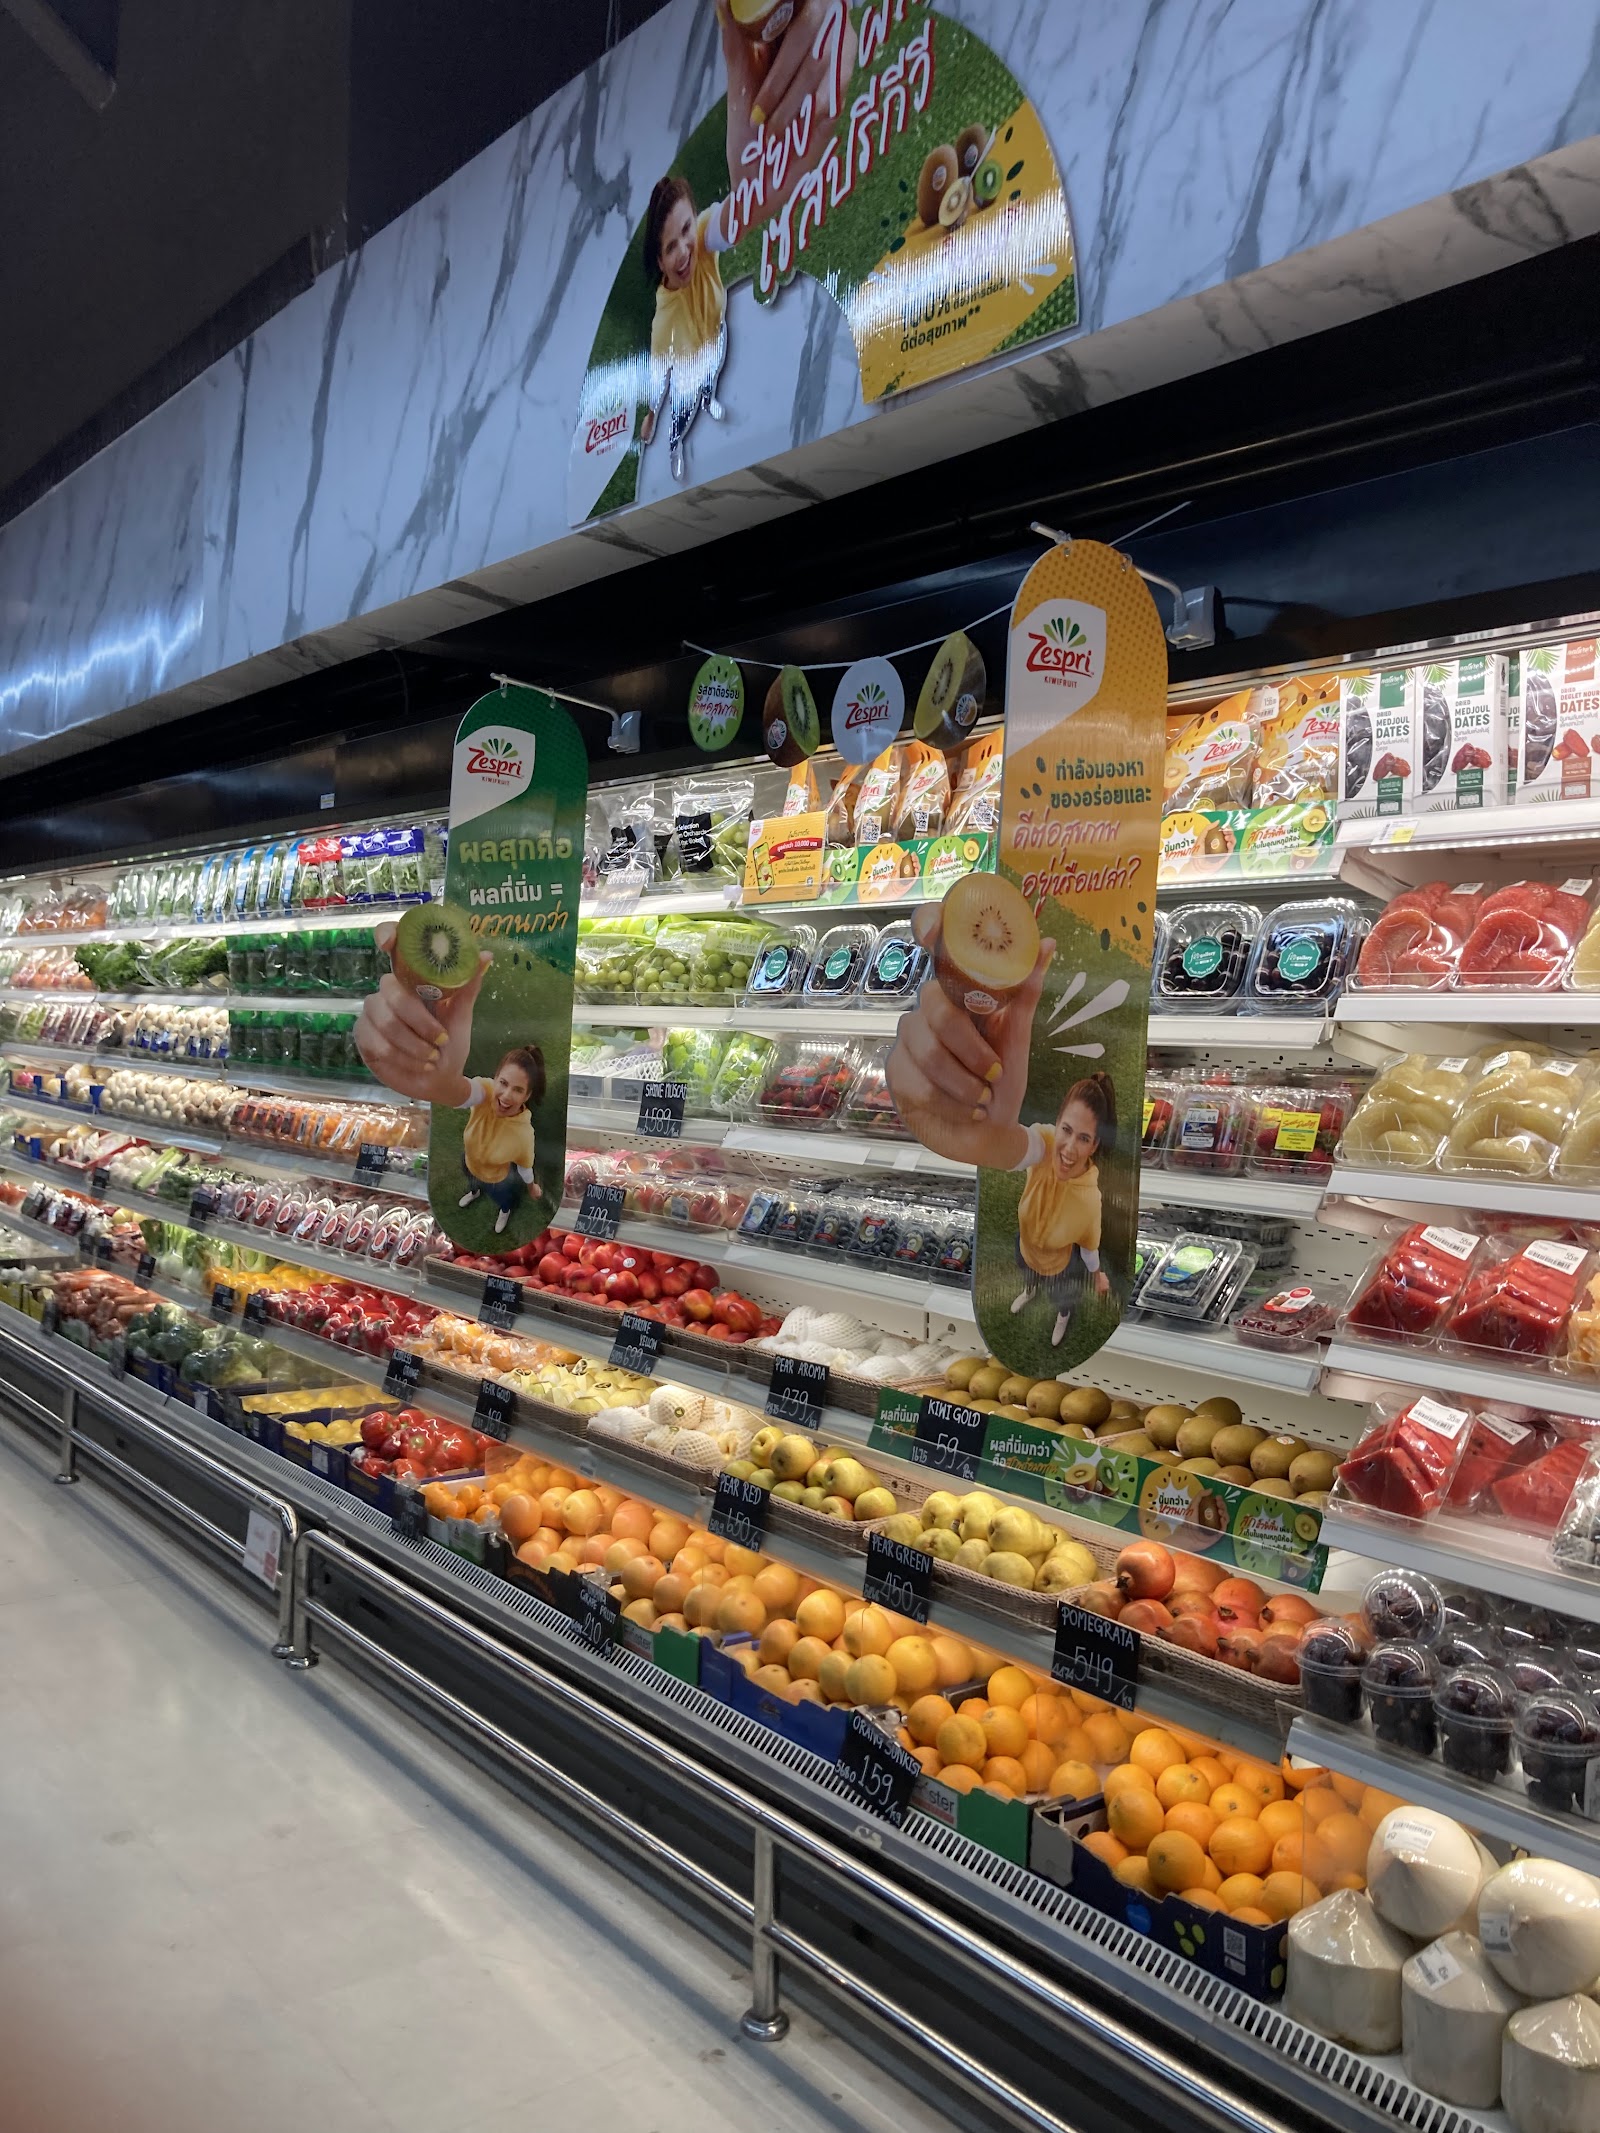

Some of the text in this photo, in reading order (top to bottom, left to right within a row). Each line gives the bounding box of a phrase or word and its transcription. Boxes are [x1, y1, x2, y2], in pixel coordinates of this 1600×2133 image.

[585, 408, 628, 454] Zespri
[1026, 632, 1095, 678] Zespri
[1044, 676, 1078, 689] KIWIFRUIT
[1560, 692, 1582, 701] DEGLET
[1560, 697, 1600, 714] DATES
[845, 700, 890, 729] Zespri
[1376, 716, 1410, 727] MEDJOUL
[1454, 705, 1490, 717] MEDJOUL
[1454, 714, 1490, 728] DATES
[1376, 725, 1410, 739] DATES
[467, 747, 523, 779] Zespri
[1055, 758, 1145, 781] กำลังมองหา
[1050, 785, 1152, 809] ของอร่อยและ
[458, 829, 573, 870] ผลสุกคือ
[1013, 808, 1121, 864] ดีต่อสุขภาพ
[775, 1356, 826, 1381] PEAR AROMA
[927, 1399, 981, 1429] KIWI GOLD
[989, 1433, 1050, 1458] ผลที่นิ่มกว่า
[719, 1473, 762, 1506] PEAR RED
[872, 1534, 931, 1574] PEAR GREEN
[1061, 1606, 1135, 1652] POMEGRATA
[884, 1740, 922, 1778] SUNKIST
